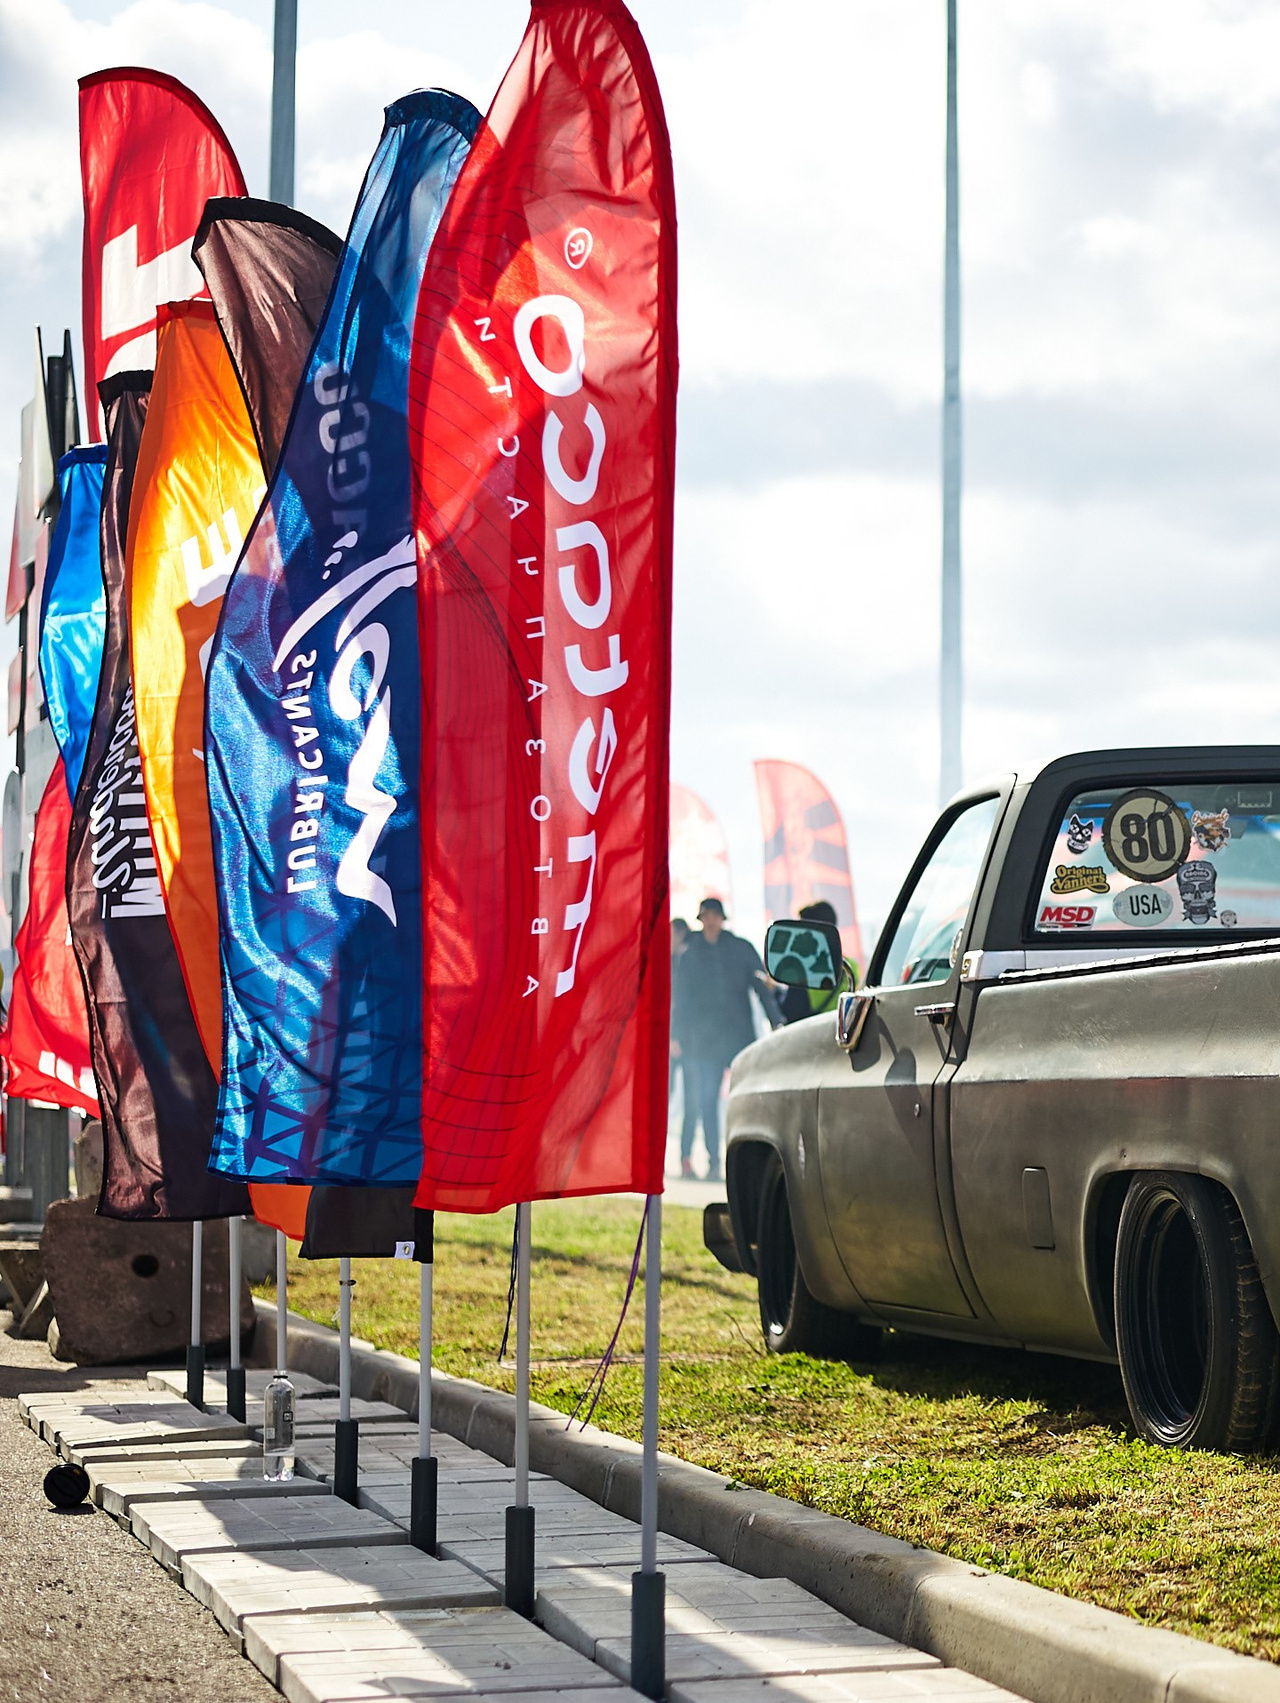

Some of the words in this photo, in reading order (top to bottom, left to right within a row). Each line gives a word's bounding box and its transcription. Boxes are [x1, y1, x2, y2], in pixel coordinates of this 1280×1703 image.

[1120, 812, 1177, 863] 80
[1056, 866, 1102, 879] Original
[1053, 875, 1107, 891] Vanners
[1130, 894, 1162, 916] USA
[1039, 907, 1094, 922] MSD
